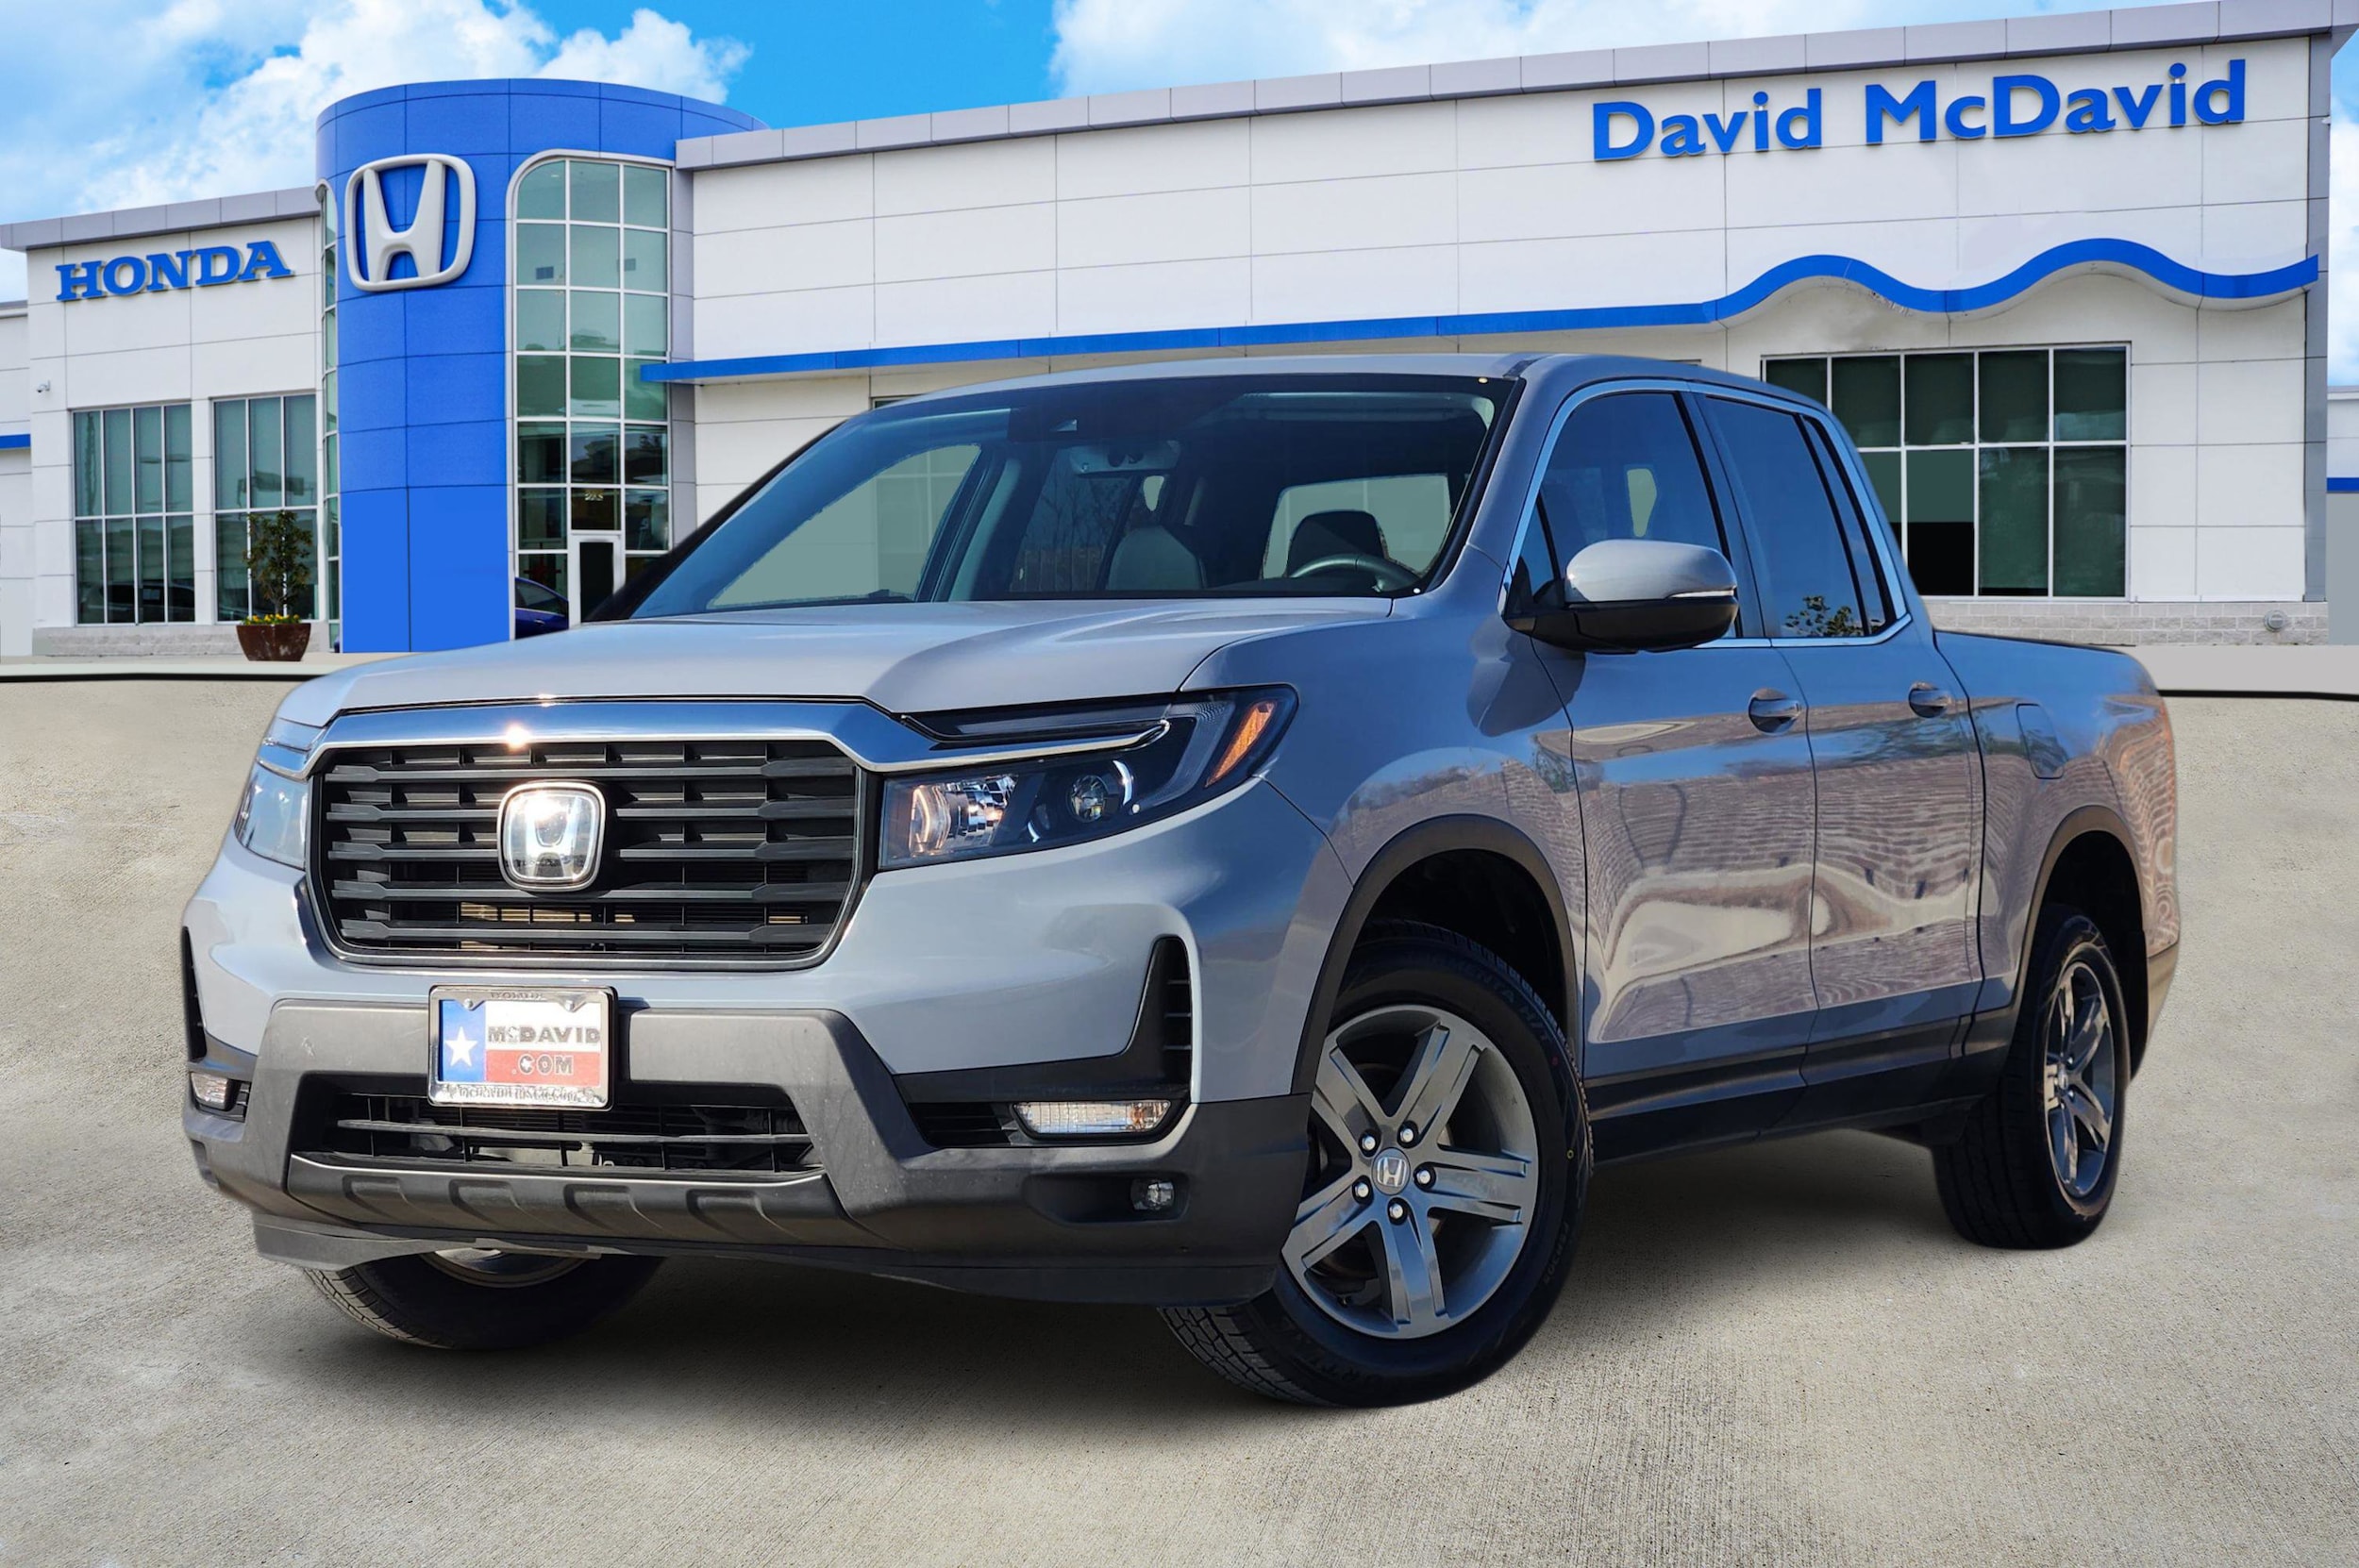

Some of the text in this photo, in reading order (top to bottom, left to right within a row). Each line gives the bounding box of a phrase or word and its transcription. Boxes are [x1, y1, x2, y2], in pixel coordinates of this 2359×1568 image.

[1593, 58, 2246, 161] David McDavid
[56, 240, 293, 302] HONDA
